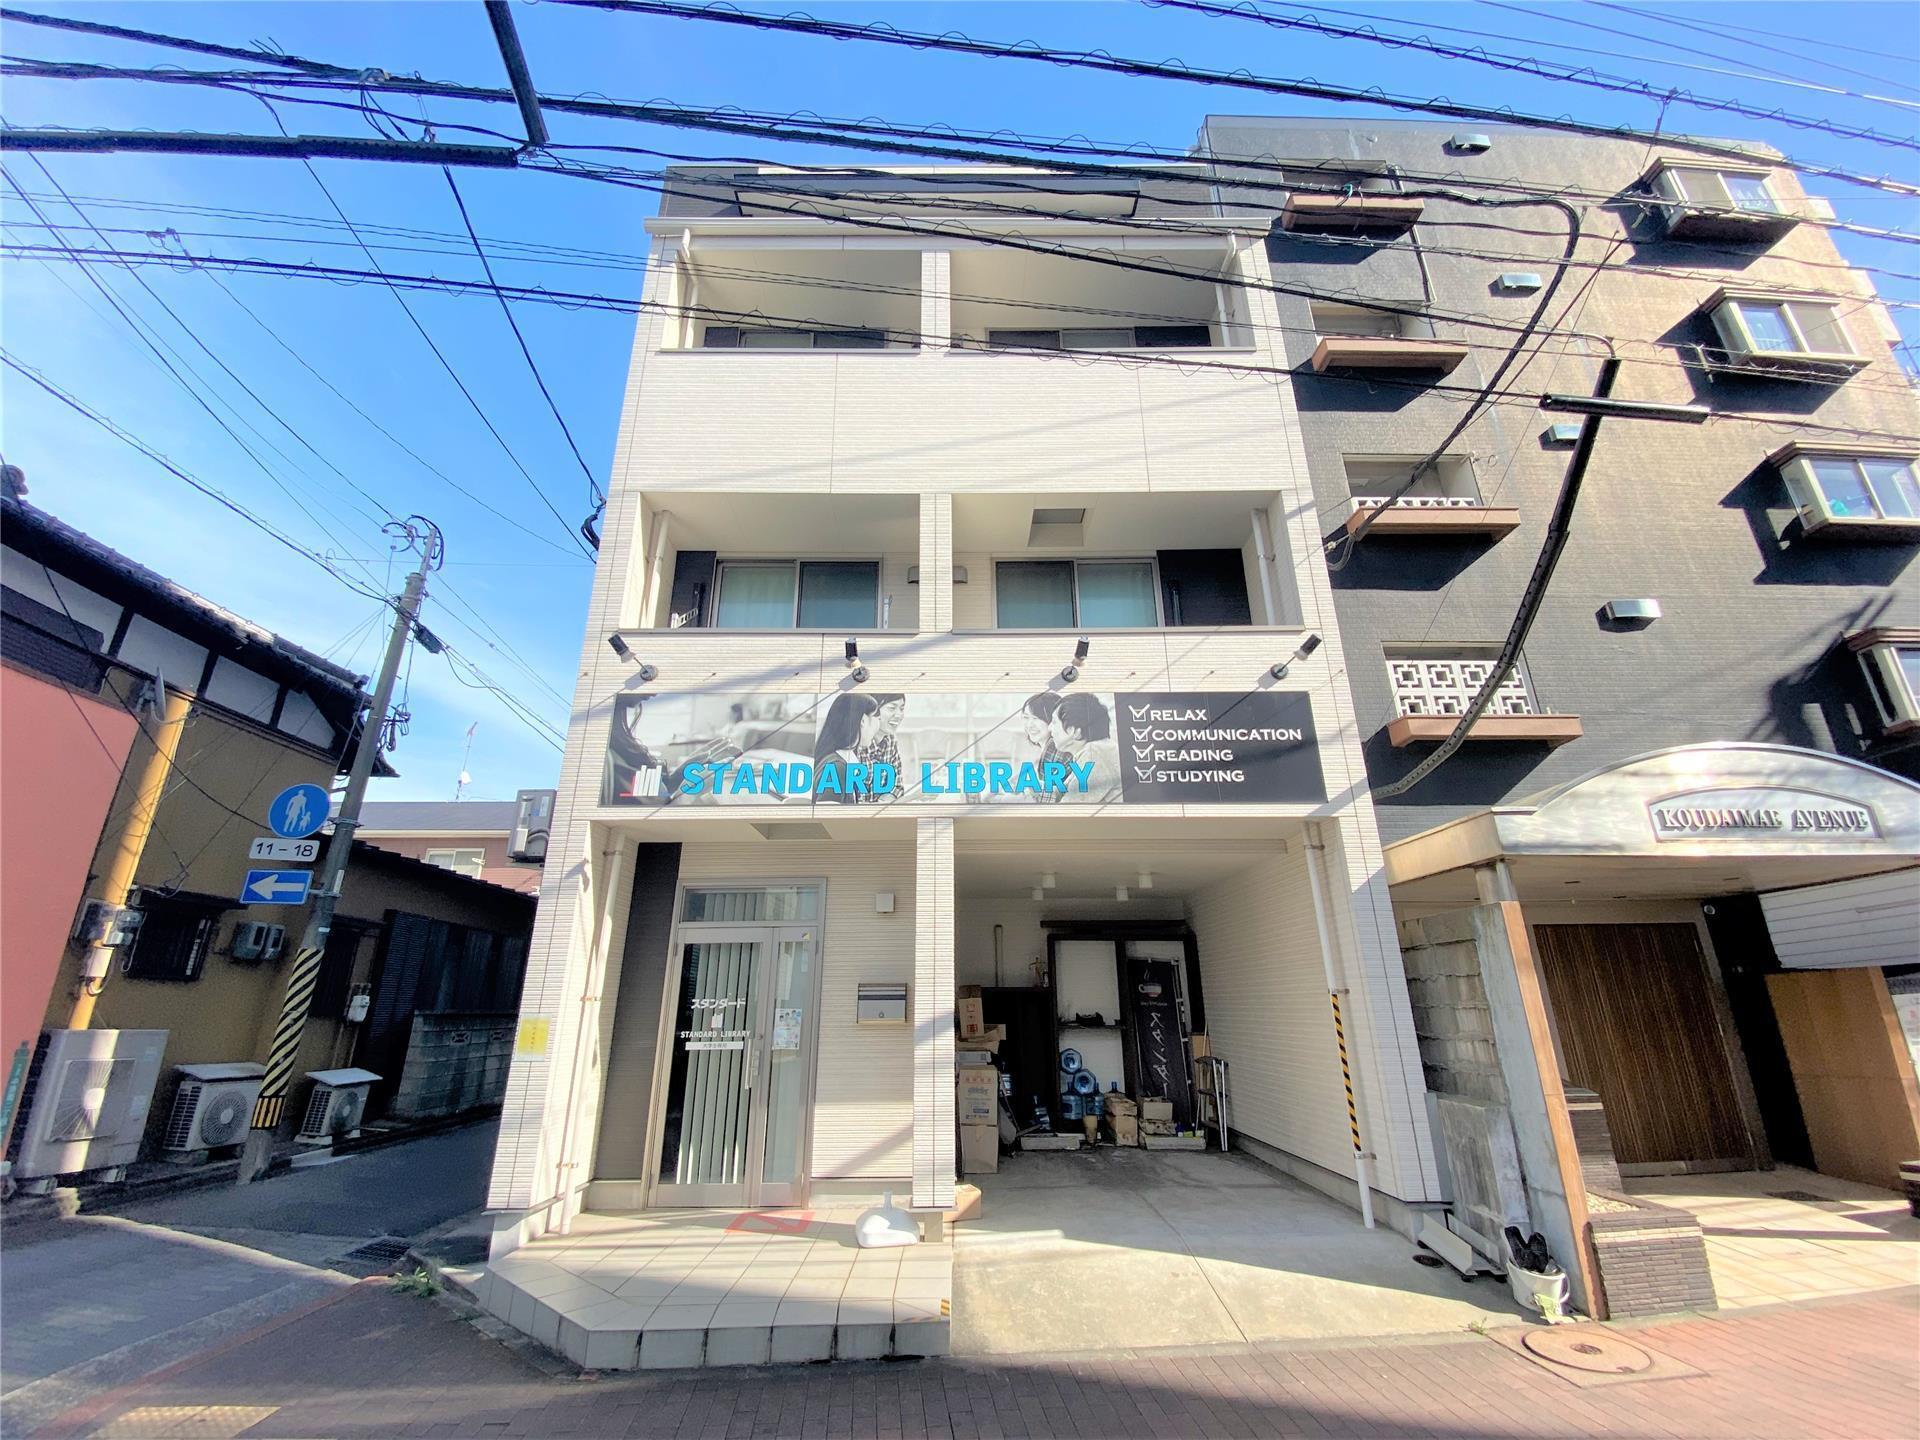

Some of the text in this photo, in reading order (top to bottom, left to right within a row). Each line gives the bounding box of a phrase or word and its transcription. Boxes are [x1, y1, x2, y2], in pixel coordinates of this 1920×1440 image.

[1150, 709, 1207, 721] RELAX
[1152, 729, 1302, 741] COMMUNICATION
[1154, 750, 1234, 762] READING
[680, 762, 1096, 795] STANDARD LIBRARY
[1156, 770, 1245, 782] STUDYING
[1655, 808, 1868, 831] KOUDAIMAE AVENUE
[691, 998, 746, 1009] スタンダード
[680, 1030, 751, 1039] STANDARD LIBRARY
